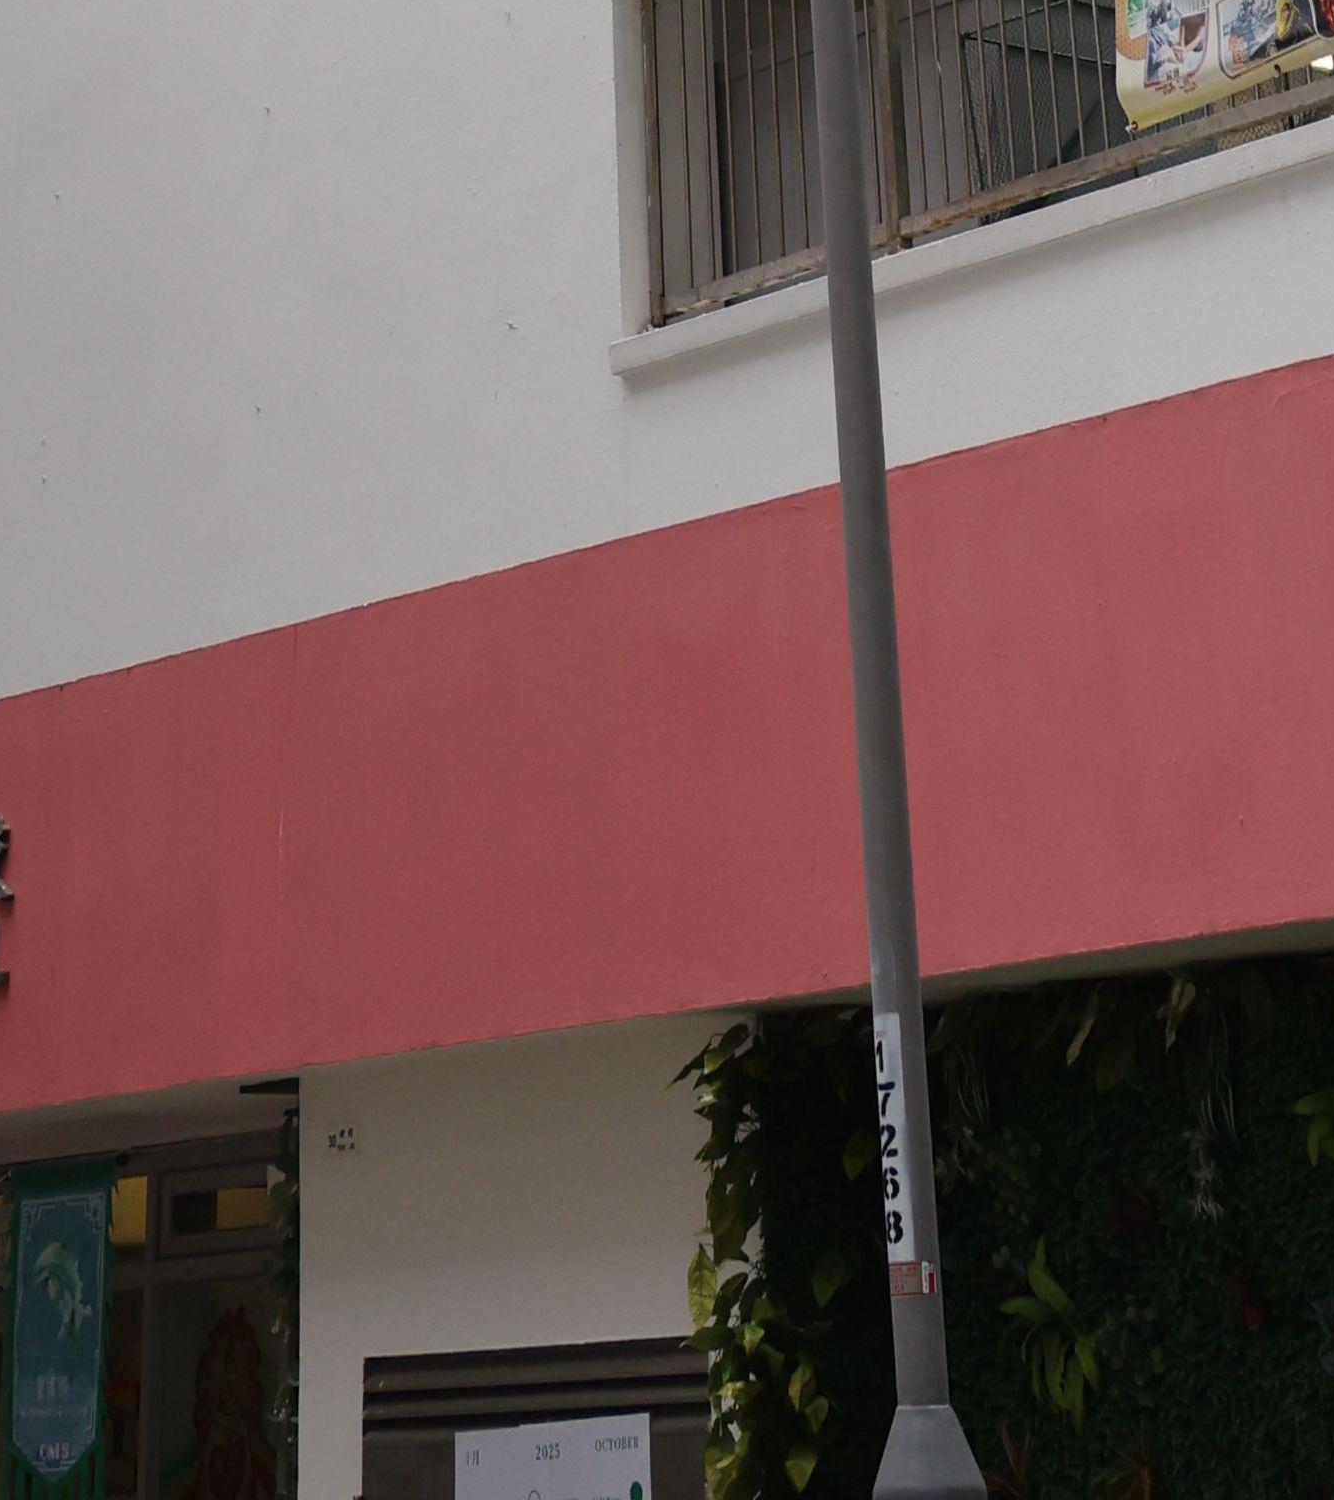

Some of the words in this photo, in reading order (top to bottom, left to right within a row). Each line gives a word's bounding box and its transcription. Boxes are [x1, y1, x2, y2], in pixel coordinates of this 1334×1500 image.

[875, 1040, 905, 1244] 17268
[535, 1442, 561, 1461] 2025
[594, 1436, 639, 1453] OCTOBER
